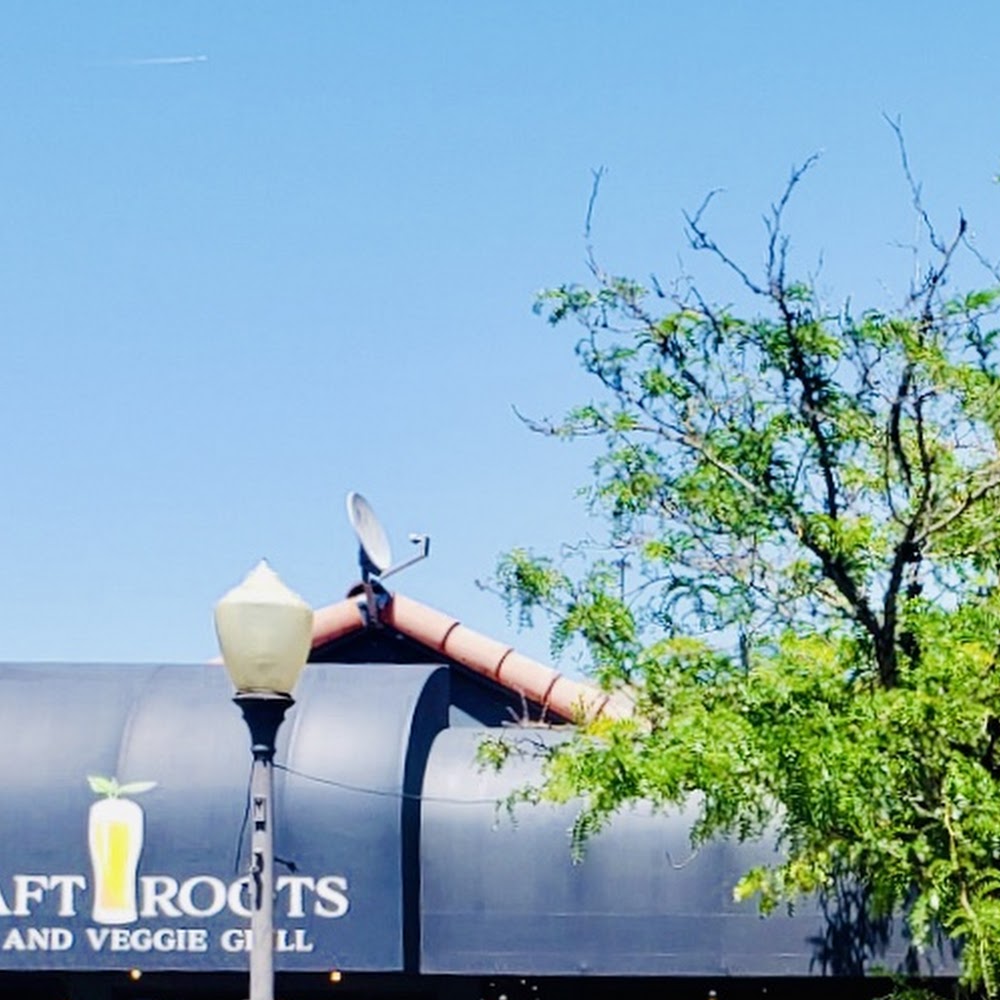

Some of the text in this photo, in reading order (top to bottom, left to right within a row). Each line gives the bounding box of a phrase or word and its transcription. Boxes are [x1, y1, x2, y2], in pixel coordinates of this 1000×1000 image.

[2, 927, 314, 953] AND VEGGIE GLL
